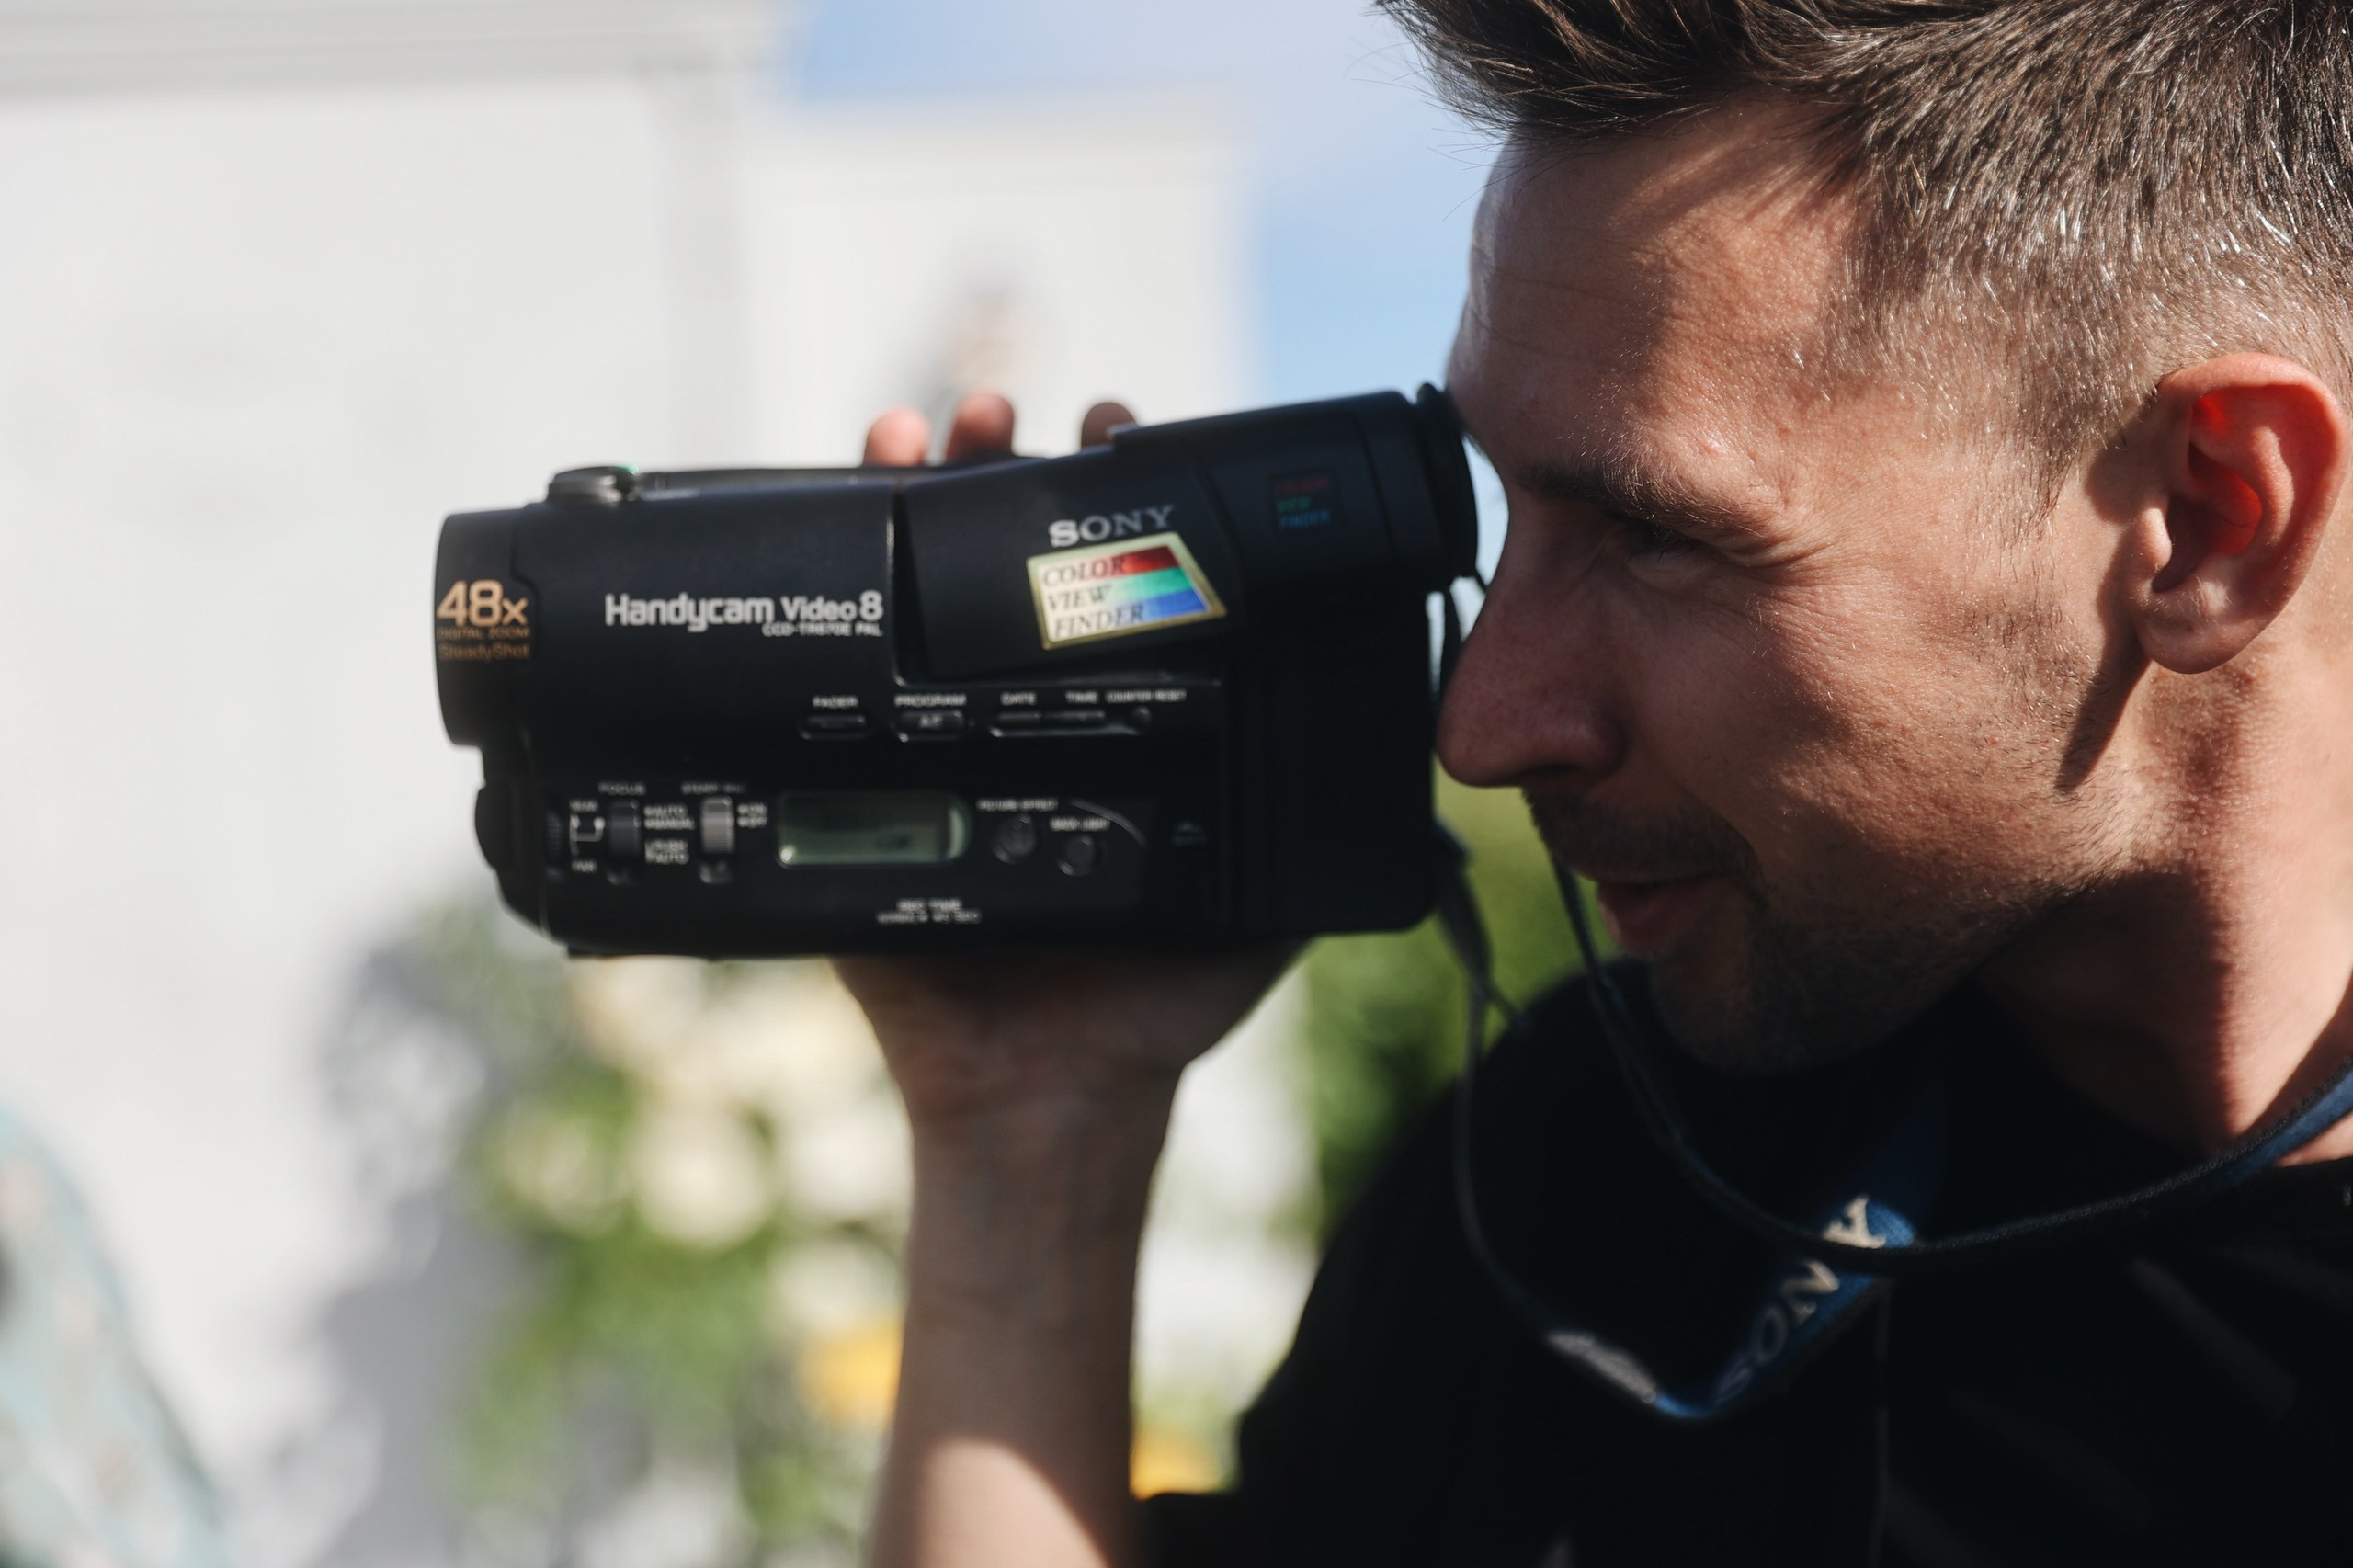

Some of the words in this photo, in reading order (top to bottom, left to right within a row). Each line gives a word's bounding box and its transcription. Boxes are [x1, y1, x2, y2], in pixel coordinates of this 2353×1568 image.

[1048, 505, 1175, 548] SONY
[1042, 555, 1126, 587] COLOR
[436, 578, 529, 627] 48x
[1046, 584, 1114, 613] VIEW
[605, 593, 774, 632] Handycam
[855, 621, 883, 638] PAL
[1053, 604, 1145, 639] FINDER
[488, 627, 531, 640] ZOOM
[813, 695, 858, 708] FADER
[894, 693, 967, 708] PROGRAM
[1000, 691, 1037, 706] DATE
[1065, 690, 1099, 703] TIME
[598, 782, 646, 796] FOCUS
